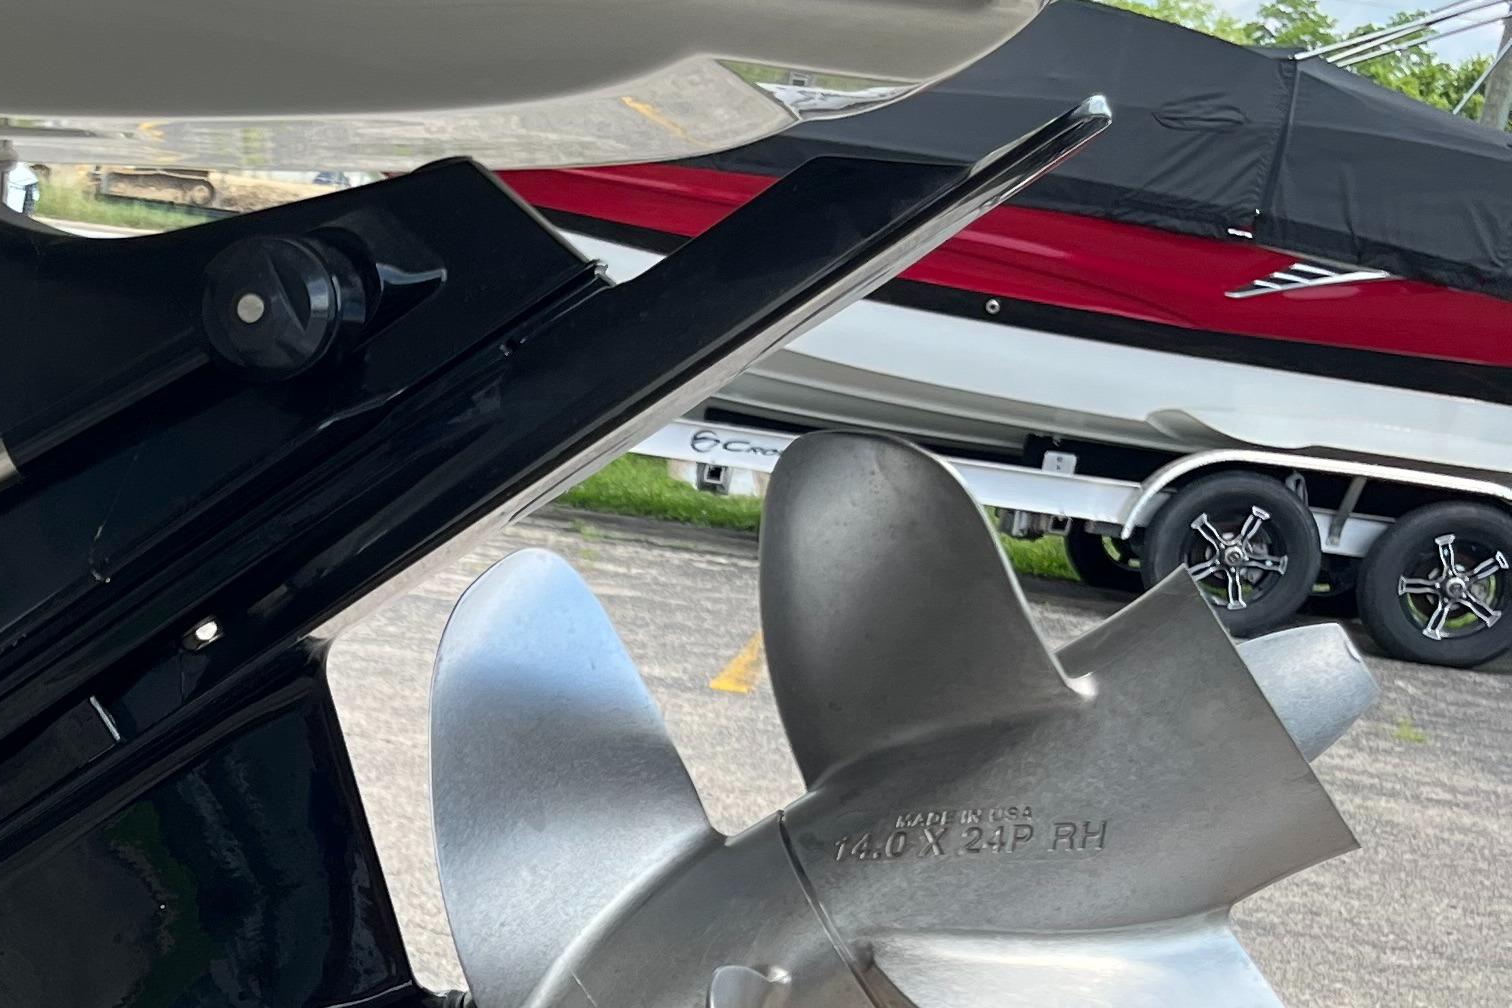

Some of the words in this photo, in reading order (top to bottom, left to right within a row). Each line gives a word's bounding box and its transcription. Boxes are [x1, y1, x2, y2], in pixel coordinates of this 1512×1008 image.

[895, 809, 952, 828] MADE
[960, 809, 981, 825] IN
[989, 806, 1033, 825] USA
[834, 830, 908, 862] 14.0
[919, 827, 949, 857] X
[958, 822, 1035, 856] 24P
[1047, 819, 1109, 853] RH
